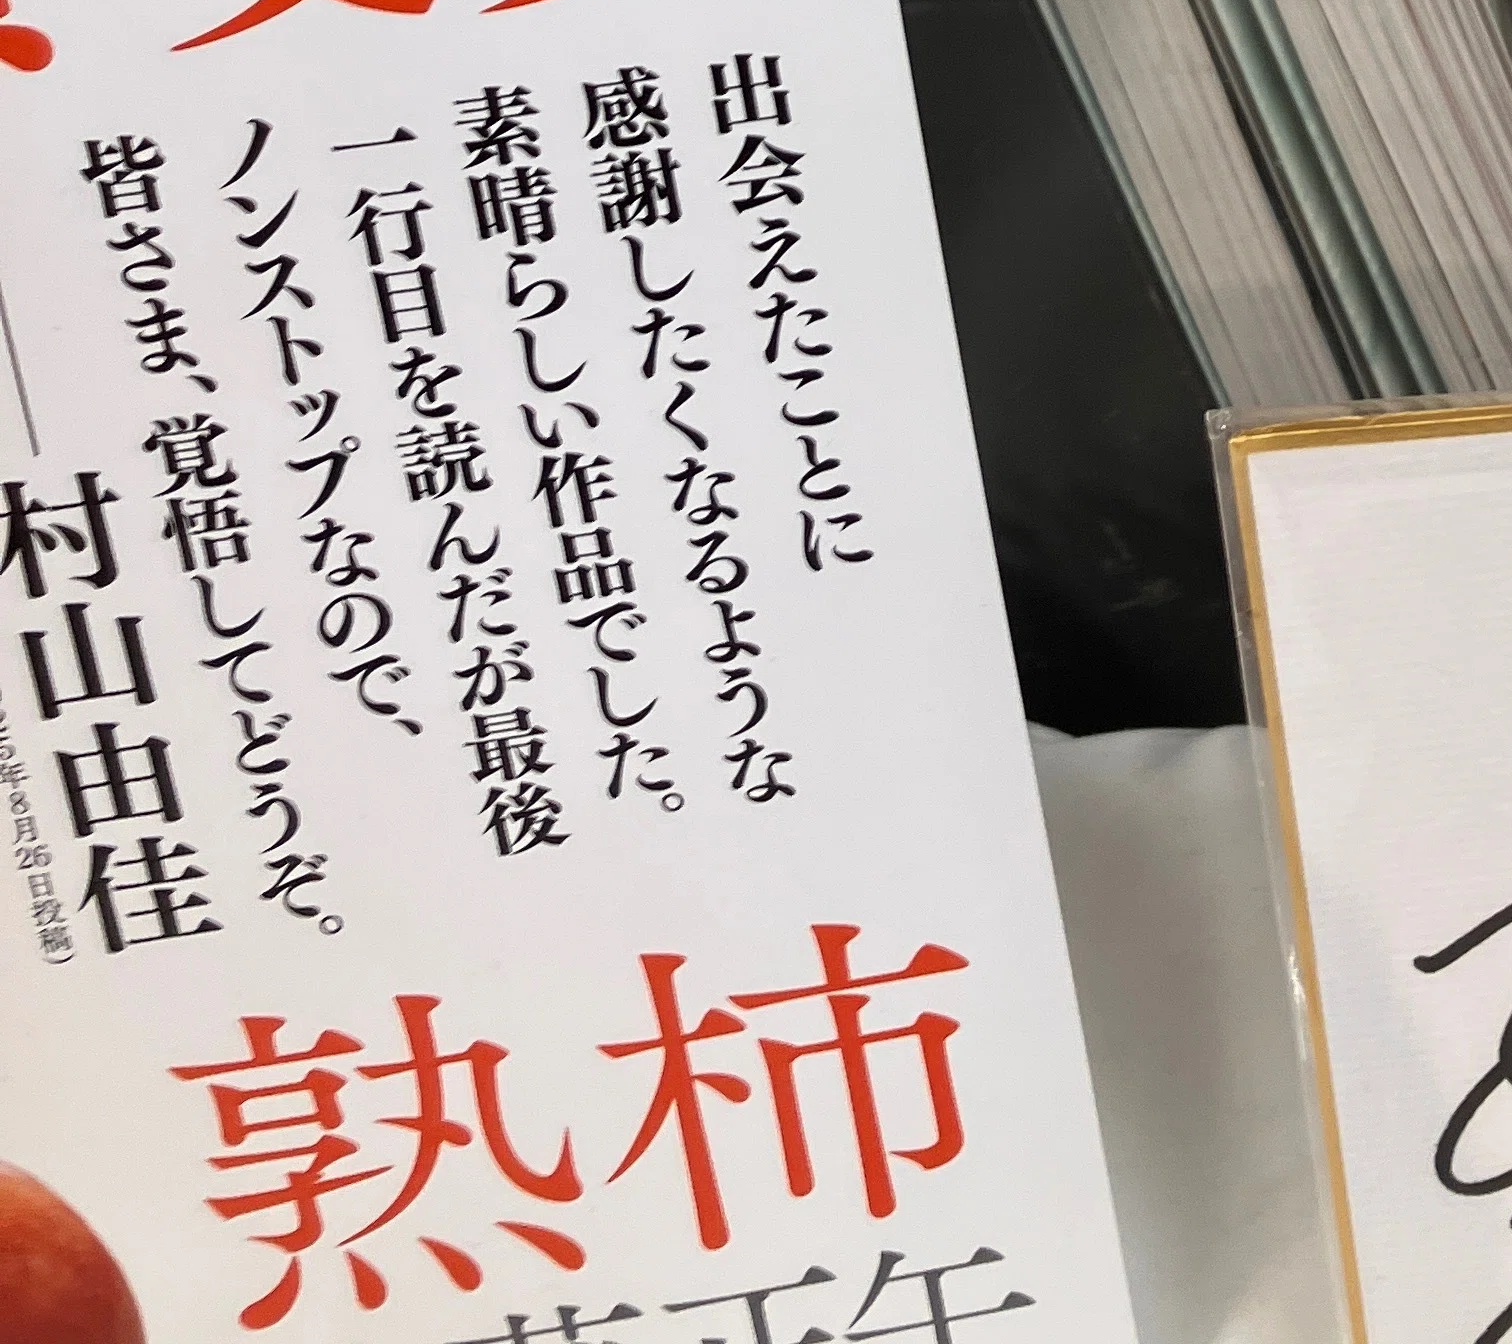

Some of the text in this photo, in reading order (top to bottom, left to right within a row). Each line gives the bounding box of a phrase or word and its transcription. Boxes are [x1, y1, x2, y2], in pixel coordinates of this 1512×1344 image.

[80, 134, 345, 935] 皆さま、覚悟してどうぞ。
[220, 117, 424, 737] ノンストップなので、
[332, 126, 572, 856] 一行目を読んだが最後
[453, 85, 686, 813] 素晴らしい作品でした。
[581, 65, 797, 803] 感謝したくなるような
[708, 52, 875, 572] 出会えたことに
[0, 470, 224, 955] 村山由佳
[168, 923, 971, 1330] 熟柿
